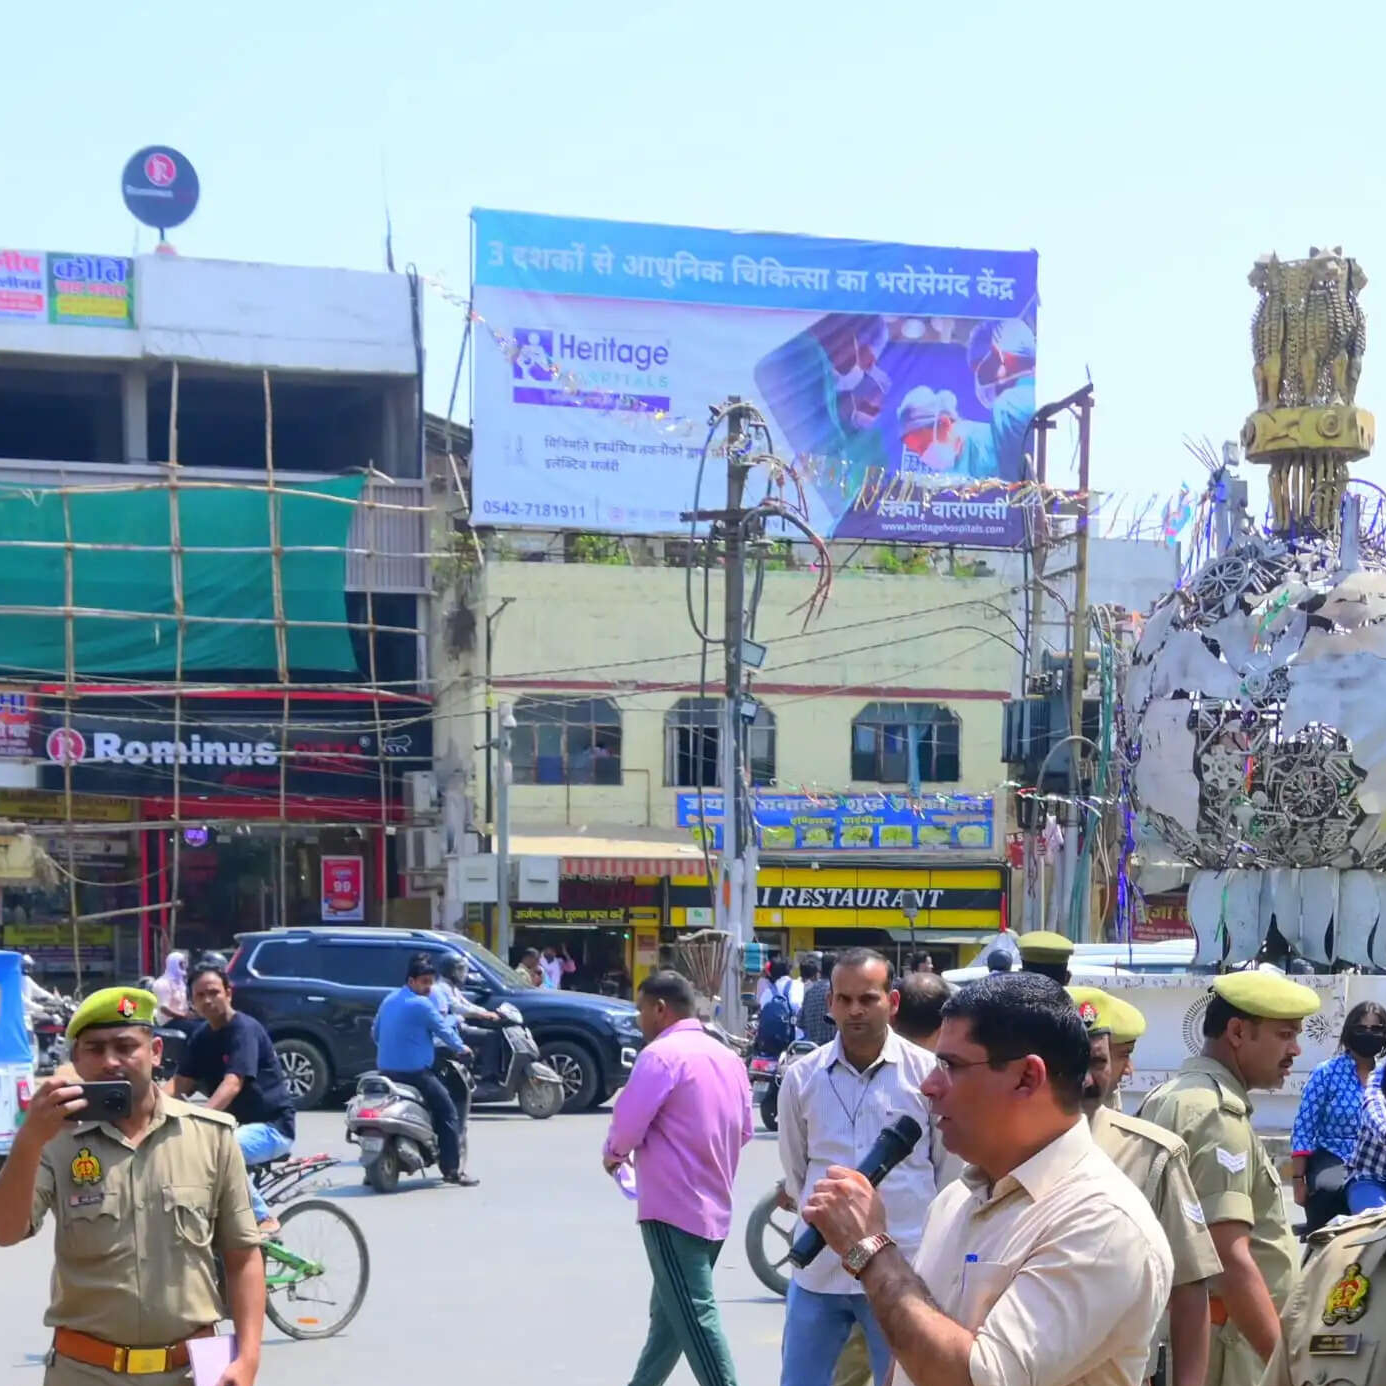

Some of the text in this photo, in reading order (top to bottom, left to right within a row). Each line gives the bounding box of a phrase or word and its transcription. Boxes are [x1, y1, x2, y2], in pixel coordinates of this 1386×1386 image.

[489, 241, 1015, 302] 3 दशकों से आधुनिक चिकित्सा का भरोसेमंद केंद्र
[559, 333, 669, 371] Heritage
[483, 500, 586, 518] 0542-7181911
[931, 497, 1007, 519] वाराणसी
[881, 522, 1005, 535] www.heritagehospitals.com
[93, 732, 278, 767] Rominus
[778, 887, 944, 908] RESTAURANT
